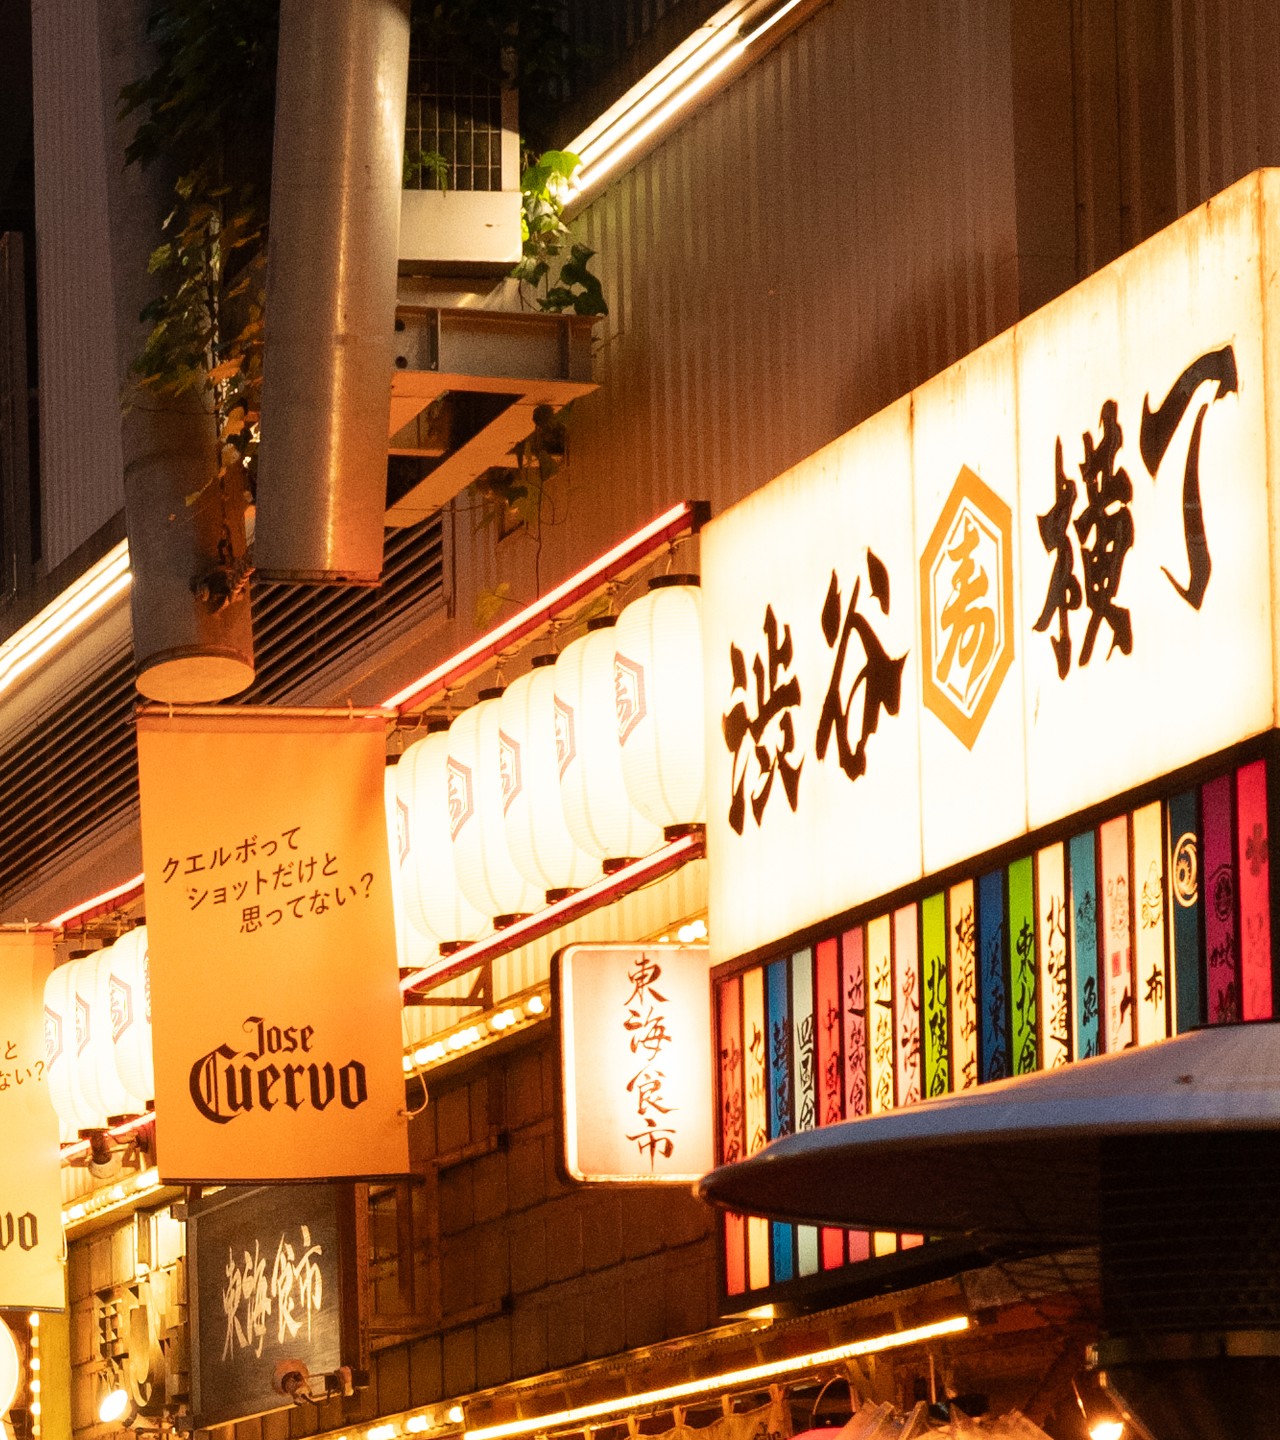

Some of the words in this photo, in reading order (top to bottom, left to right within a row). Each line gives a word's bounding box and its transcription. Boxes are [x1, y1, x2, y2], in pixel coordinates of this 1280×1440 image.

[722, 547, 909, 836] 渋谷
[1033, 344, 1239, 681] 横丁
[162, 826, 301, 883] クエルボって
[189, 853, 338, 911] ショットだけと
[240, 872, 374, 933] 思ってない？
[242, 1016, 315, 1061] Jose
[623, 951, 679, 1173] 東海食市
[189, 1043, 368, 1125] Cuervo
